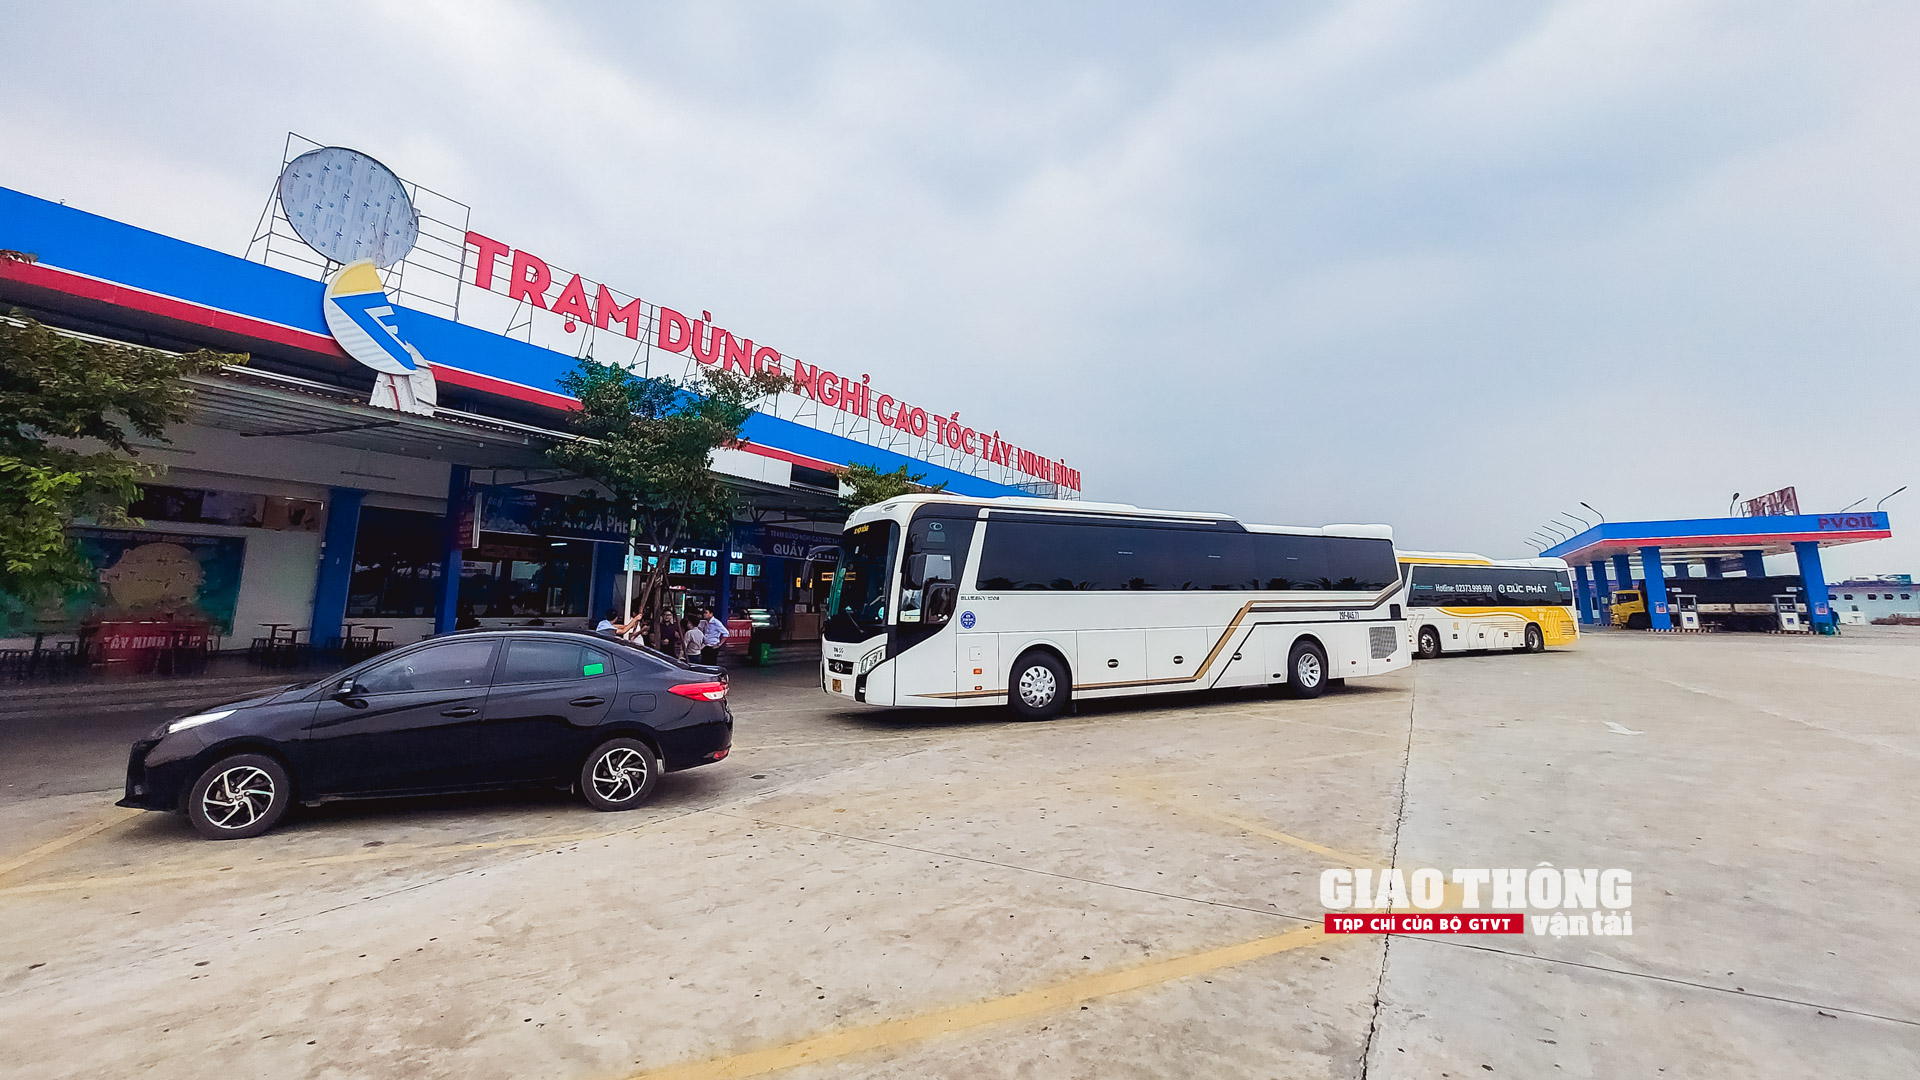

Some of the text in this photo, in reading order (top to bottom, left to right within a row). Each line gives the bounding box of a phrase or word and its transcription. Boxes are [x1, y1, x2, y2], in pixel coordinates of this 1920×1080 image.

[465, 231, 641, 340] TRẠM
[794, 359, 870, 418] NGHỈ
[877, 394, 928, 437] CAO
[934, 411, 976, 454] TỐC
[980, 429, 1013, 467] TÂY
[1017, 447, 1051, 482] NINH
[1054, 458, 1082, 492] BÌNH
[1818, 516, 1878, 529] PVOIL
[773, 540, 804, 557] QUẦY
[1525, 583, 1547, 593] PHÁT
[132, 635, 166, 649] NINH
